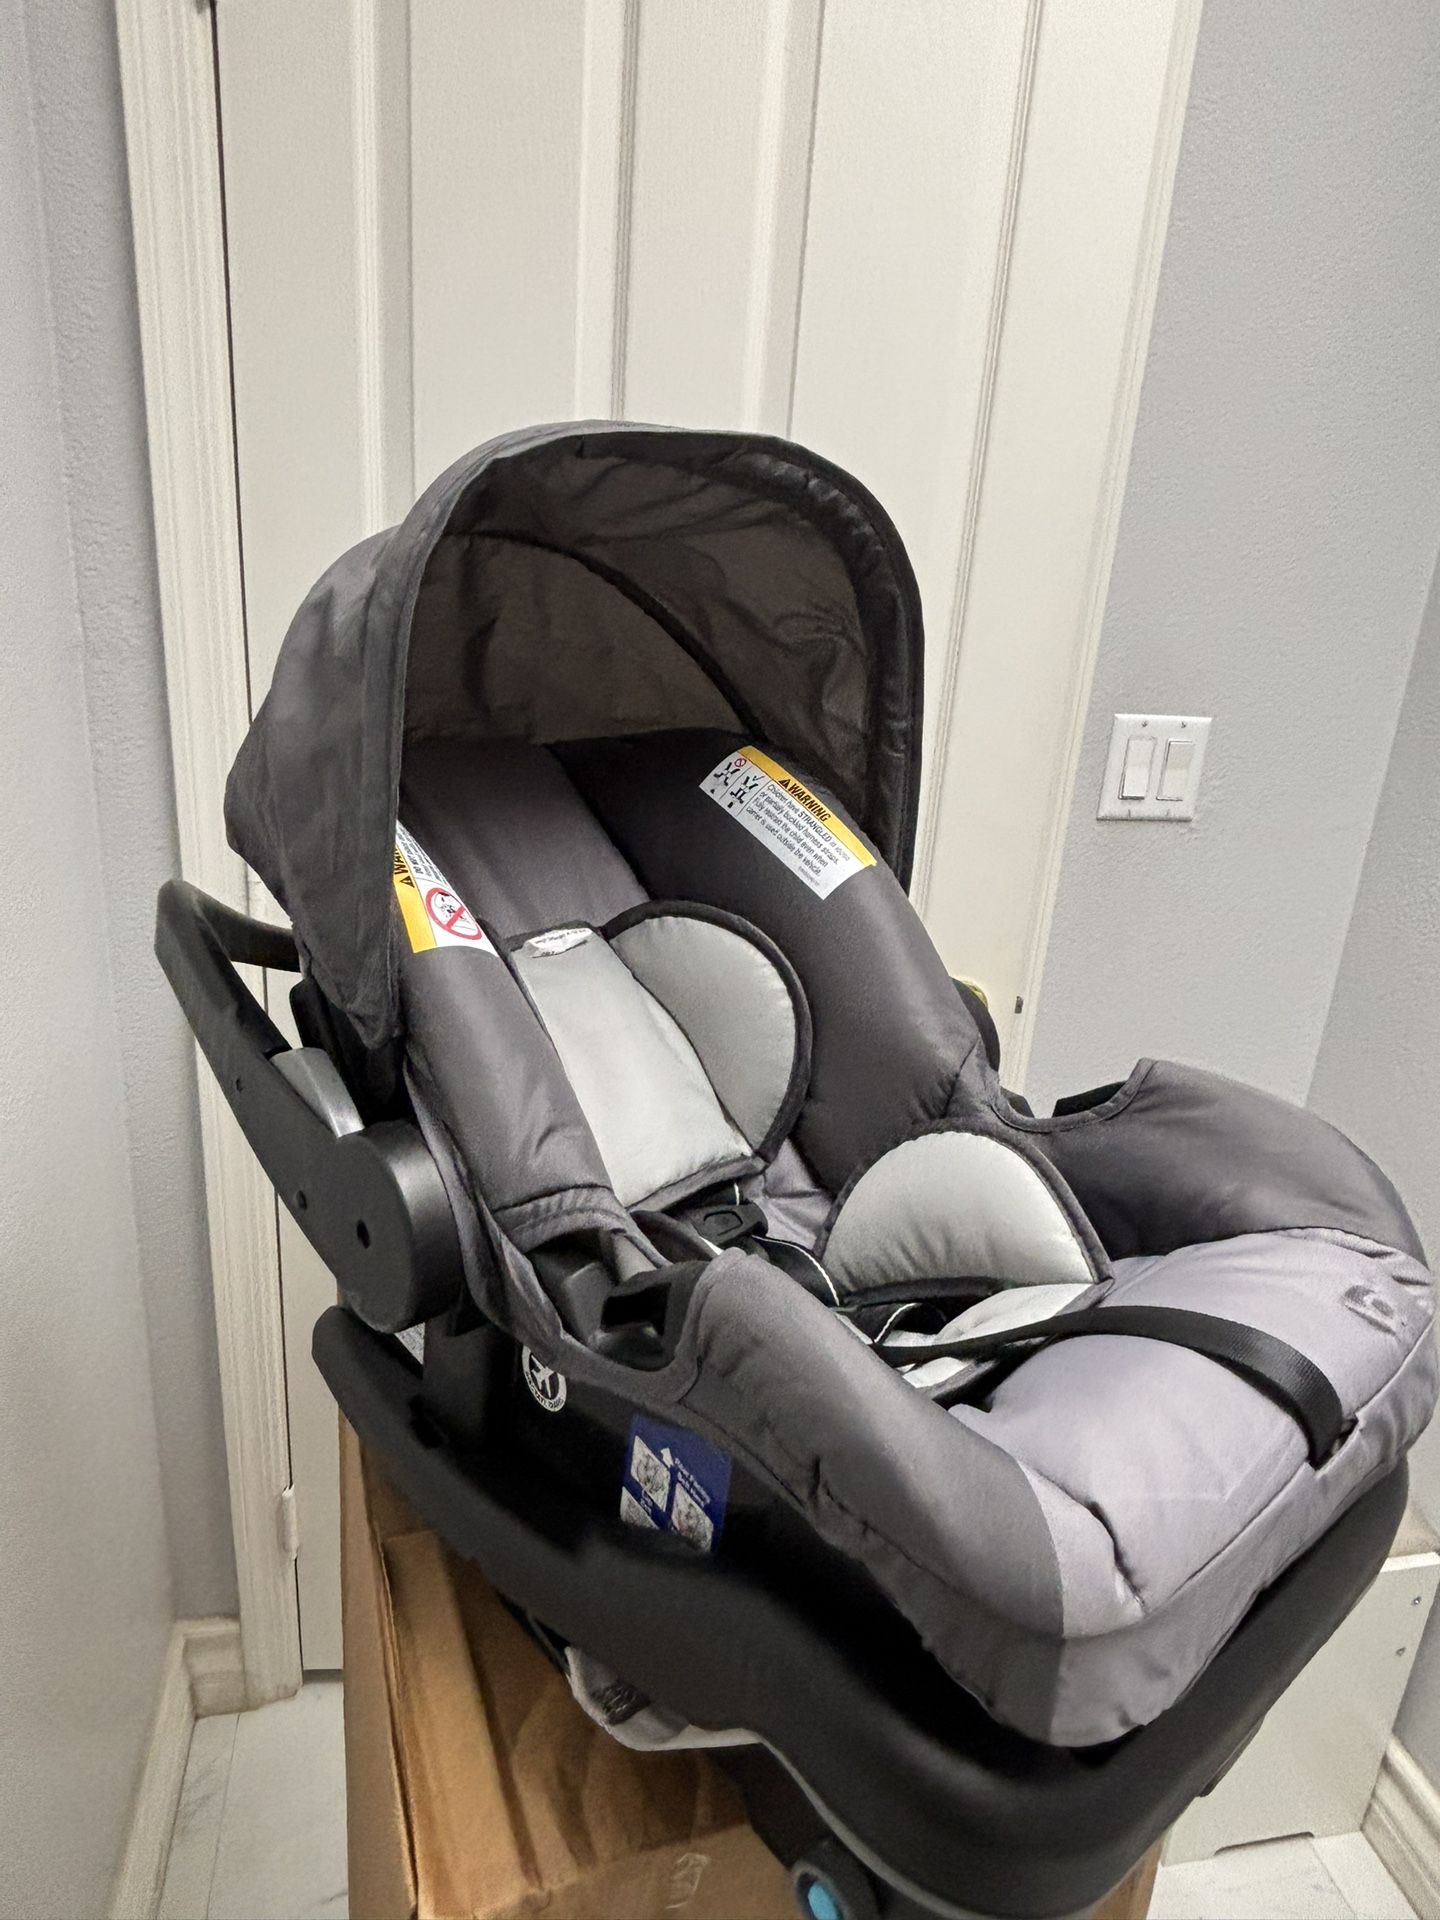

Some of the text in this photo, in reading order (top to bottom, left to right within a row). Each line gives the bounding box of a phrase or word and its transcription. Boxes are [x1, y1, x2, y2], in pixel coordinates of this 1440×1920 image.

[787, 783, 831, 822] WARNING
[751, 797, 765, 811] Fully
[779, 822, 791, 833] the
[788, 829, 803, 844] child
[799, 841, 814, 855] even
[812, 851, 829, 867] when
[764, 822, 778, 836] used
[776, 832, 796, 852] outside
[793, 848, 804, 859] the
[782, 810, 805, 831] buckled
[801, 827, 823, 849] harness
[796, 809, 832, 843] STRANGLED
